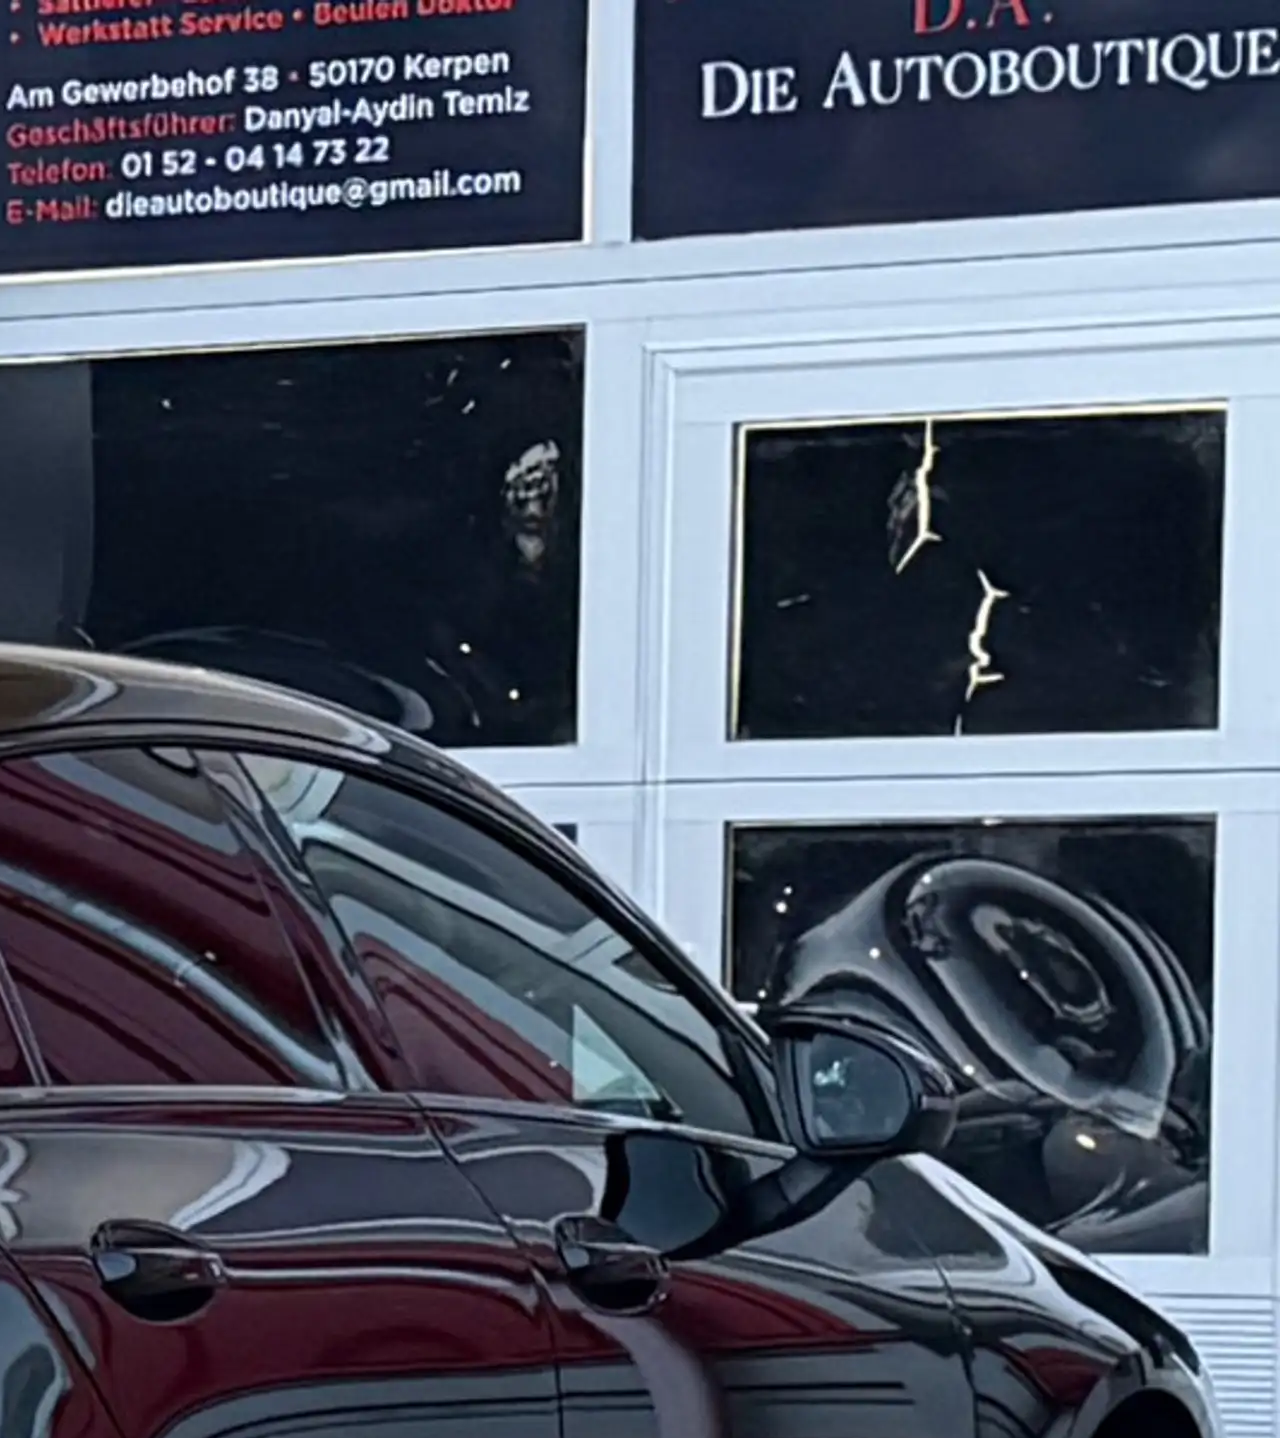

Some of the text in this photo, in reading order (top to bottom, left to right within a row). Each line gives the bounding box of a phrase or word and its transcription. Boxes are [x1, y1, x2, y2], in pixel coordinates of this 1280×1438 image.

[38, 14, 173, 47] Werkstatt
[179, 8, 284, 36] Service
[314, 0, 408, 25] Beulen
[6, 52, 509, 110] Am Gewerbehof 38 50170 Kerpen
[6, 86, 531, 149] Geschäftsführer: Danyal-Aydin Temiz
[6, 157, 113, 186] Telefon:
[121, 151, 152, 179] 01
[162, 149, 197, 177] 52
[225, 145, 264, 172] 04
[272, 141, 304, 169] 14
[312, 138, 347, 166] 73
[354, 136, 389, 163] 22
[6, 169, 521, 225] E-Mail: dieautoboutique@gmail.com
